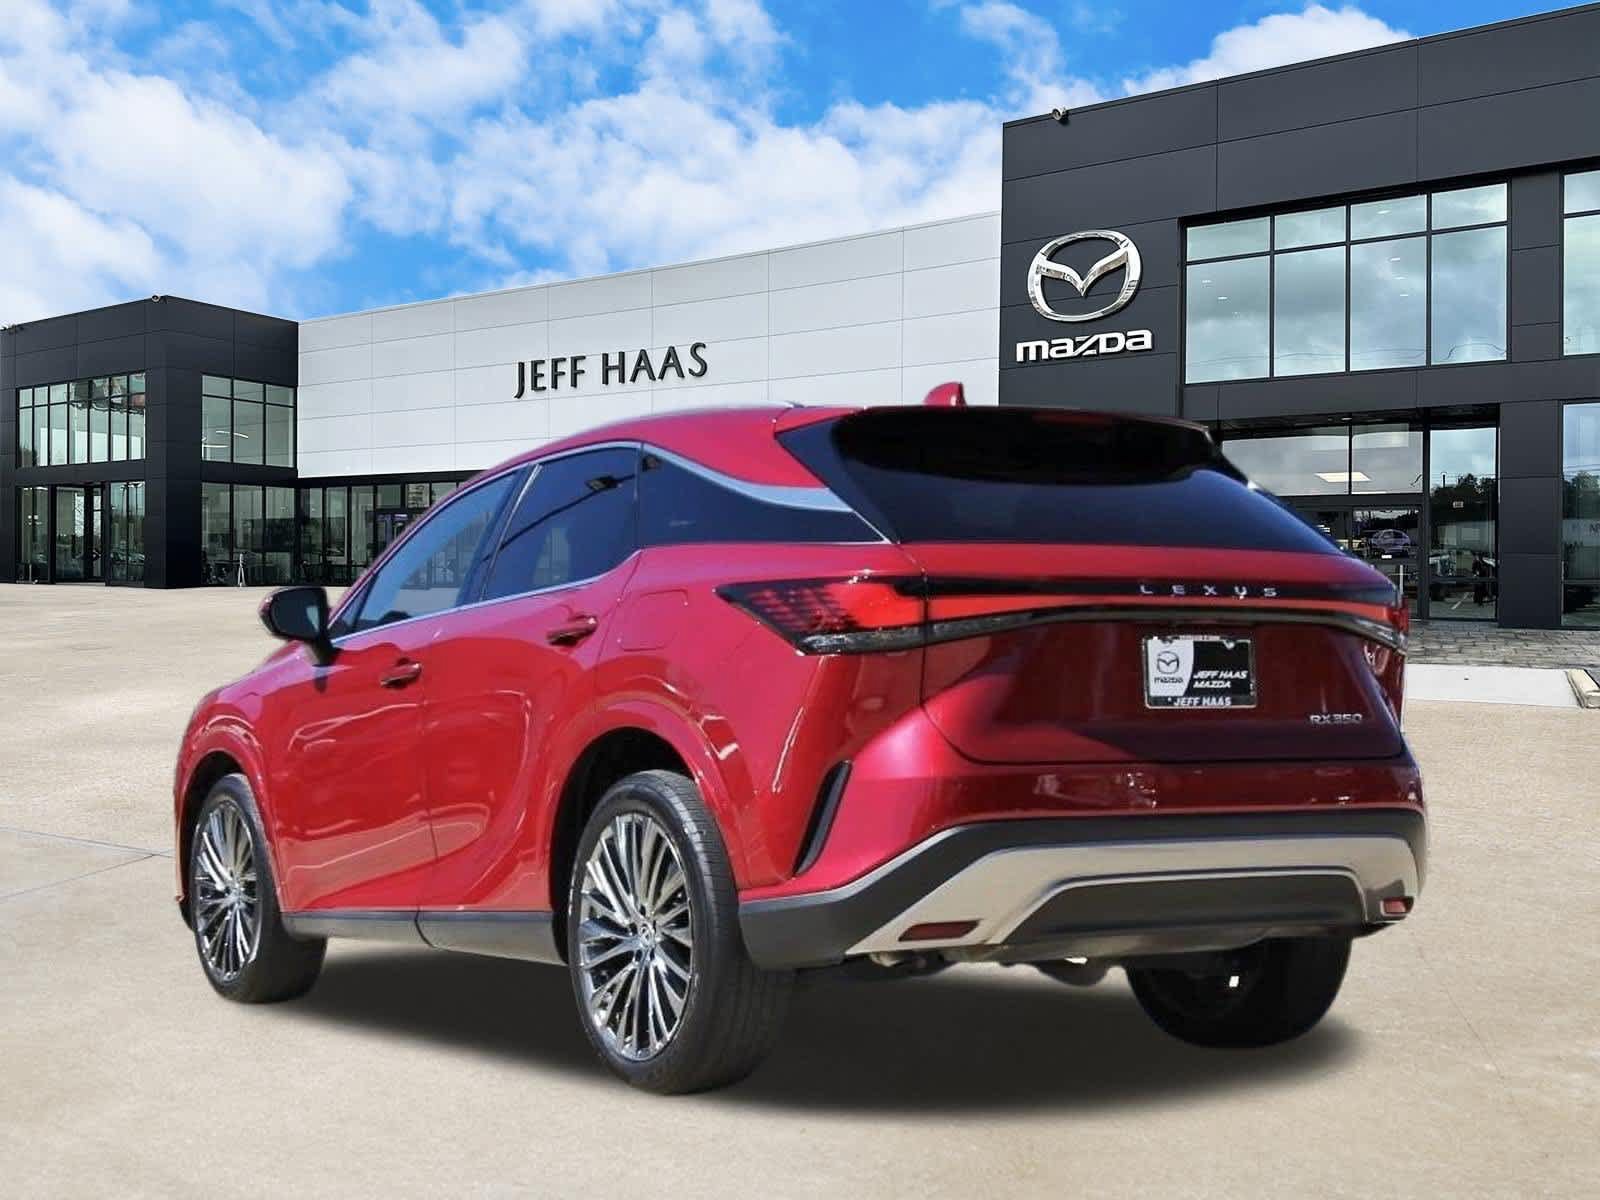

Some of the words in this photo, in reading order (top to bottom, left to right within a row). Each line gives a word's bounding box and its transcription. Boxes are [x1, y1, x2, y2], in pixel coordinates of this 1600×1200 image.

[514, 355, 586, 399] JEFF
[602, 342, 708, 385] HAAS
[1140, 584, 1277, 599] LEXUS
[1193, 671, 1218, 679] JEFF
[1219, 671, 1248, 680] HAAS
[1193, 681, 1231, 689] MAZDA
[1174, 697, 1200, 706] JEFF
[1202, 697, 1232, 706] HAAS
